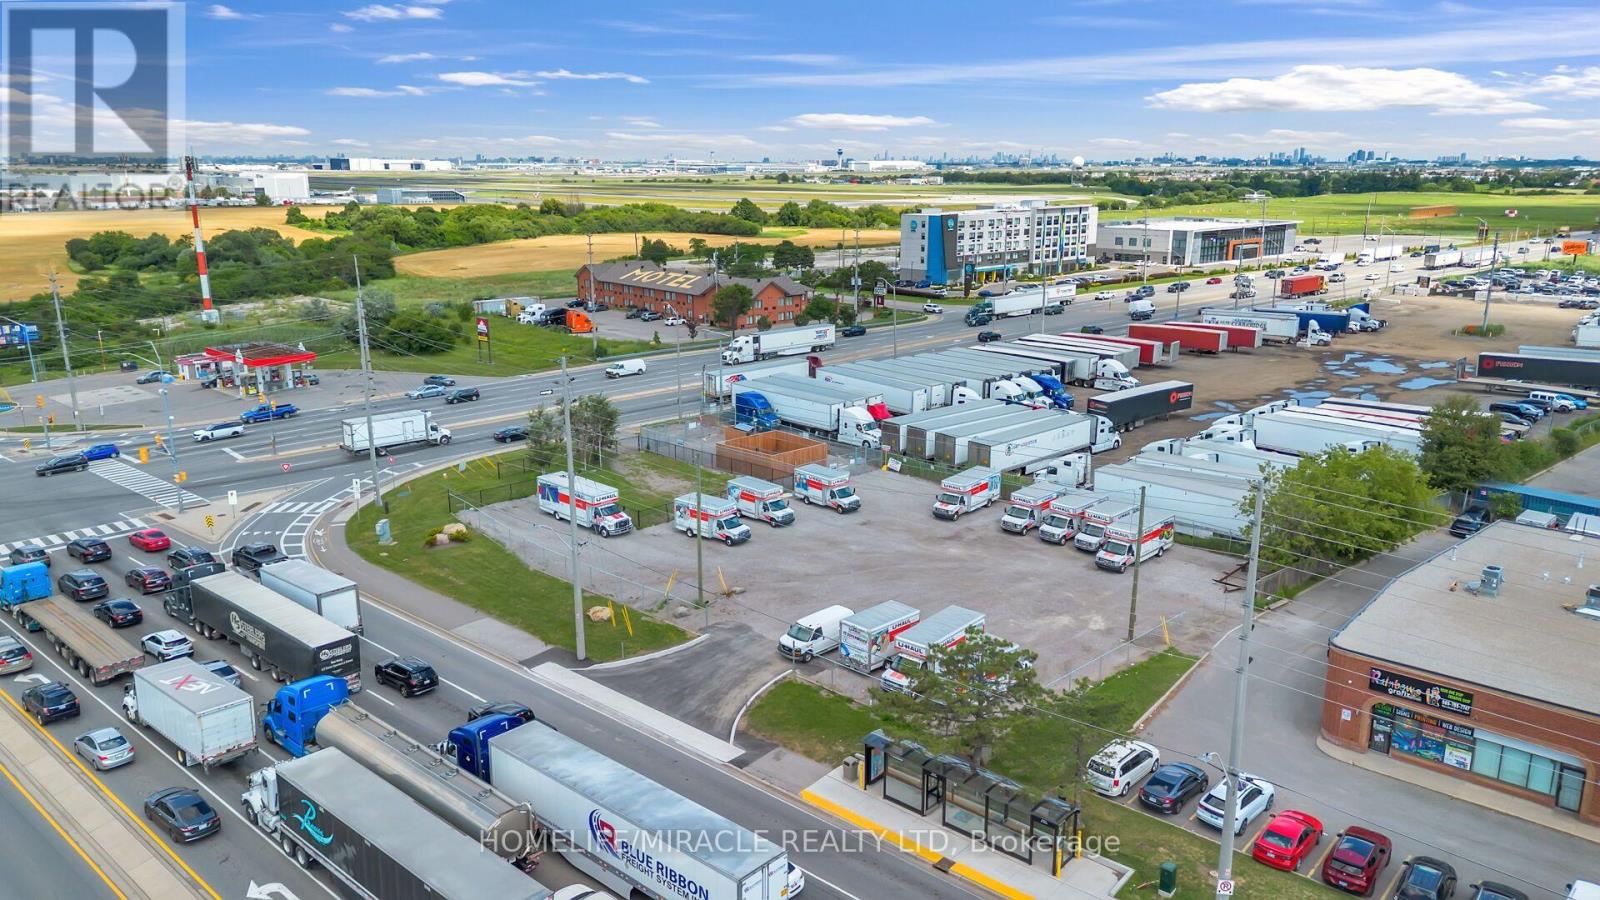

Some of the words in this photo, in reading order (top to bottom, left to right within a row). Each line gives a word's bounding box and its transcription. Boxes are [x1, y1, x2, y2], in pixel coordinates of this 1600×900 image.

[619, 268, 702, 288] MOTEL
[892, 619, 911, 629] U-HAUL
[897, 642, 923, 654] U-HAUL
[1388, 688, 1411, 698] grafix
[1395, 708, 1410, 718] SIGNS
[1442, 721, 1453, 731] WEB
[1453, 725, 1472, 735] DESIGN
[621, 841, 653, 869] BLUE
[656, 861, 709, 900] RIBBON
[621, 853, 655, 879] FREIGHT
[656, 875, 690, 900] SYSTEM
